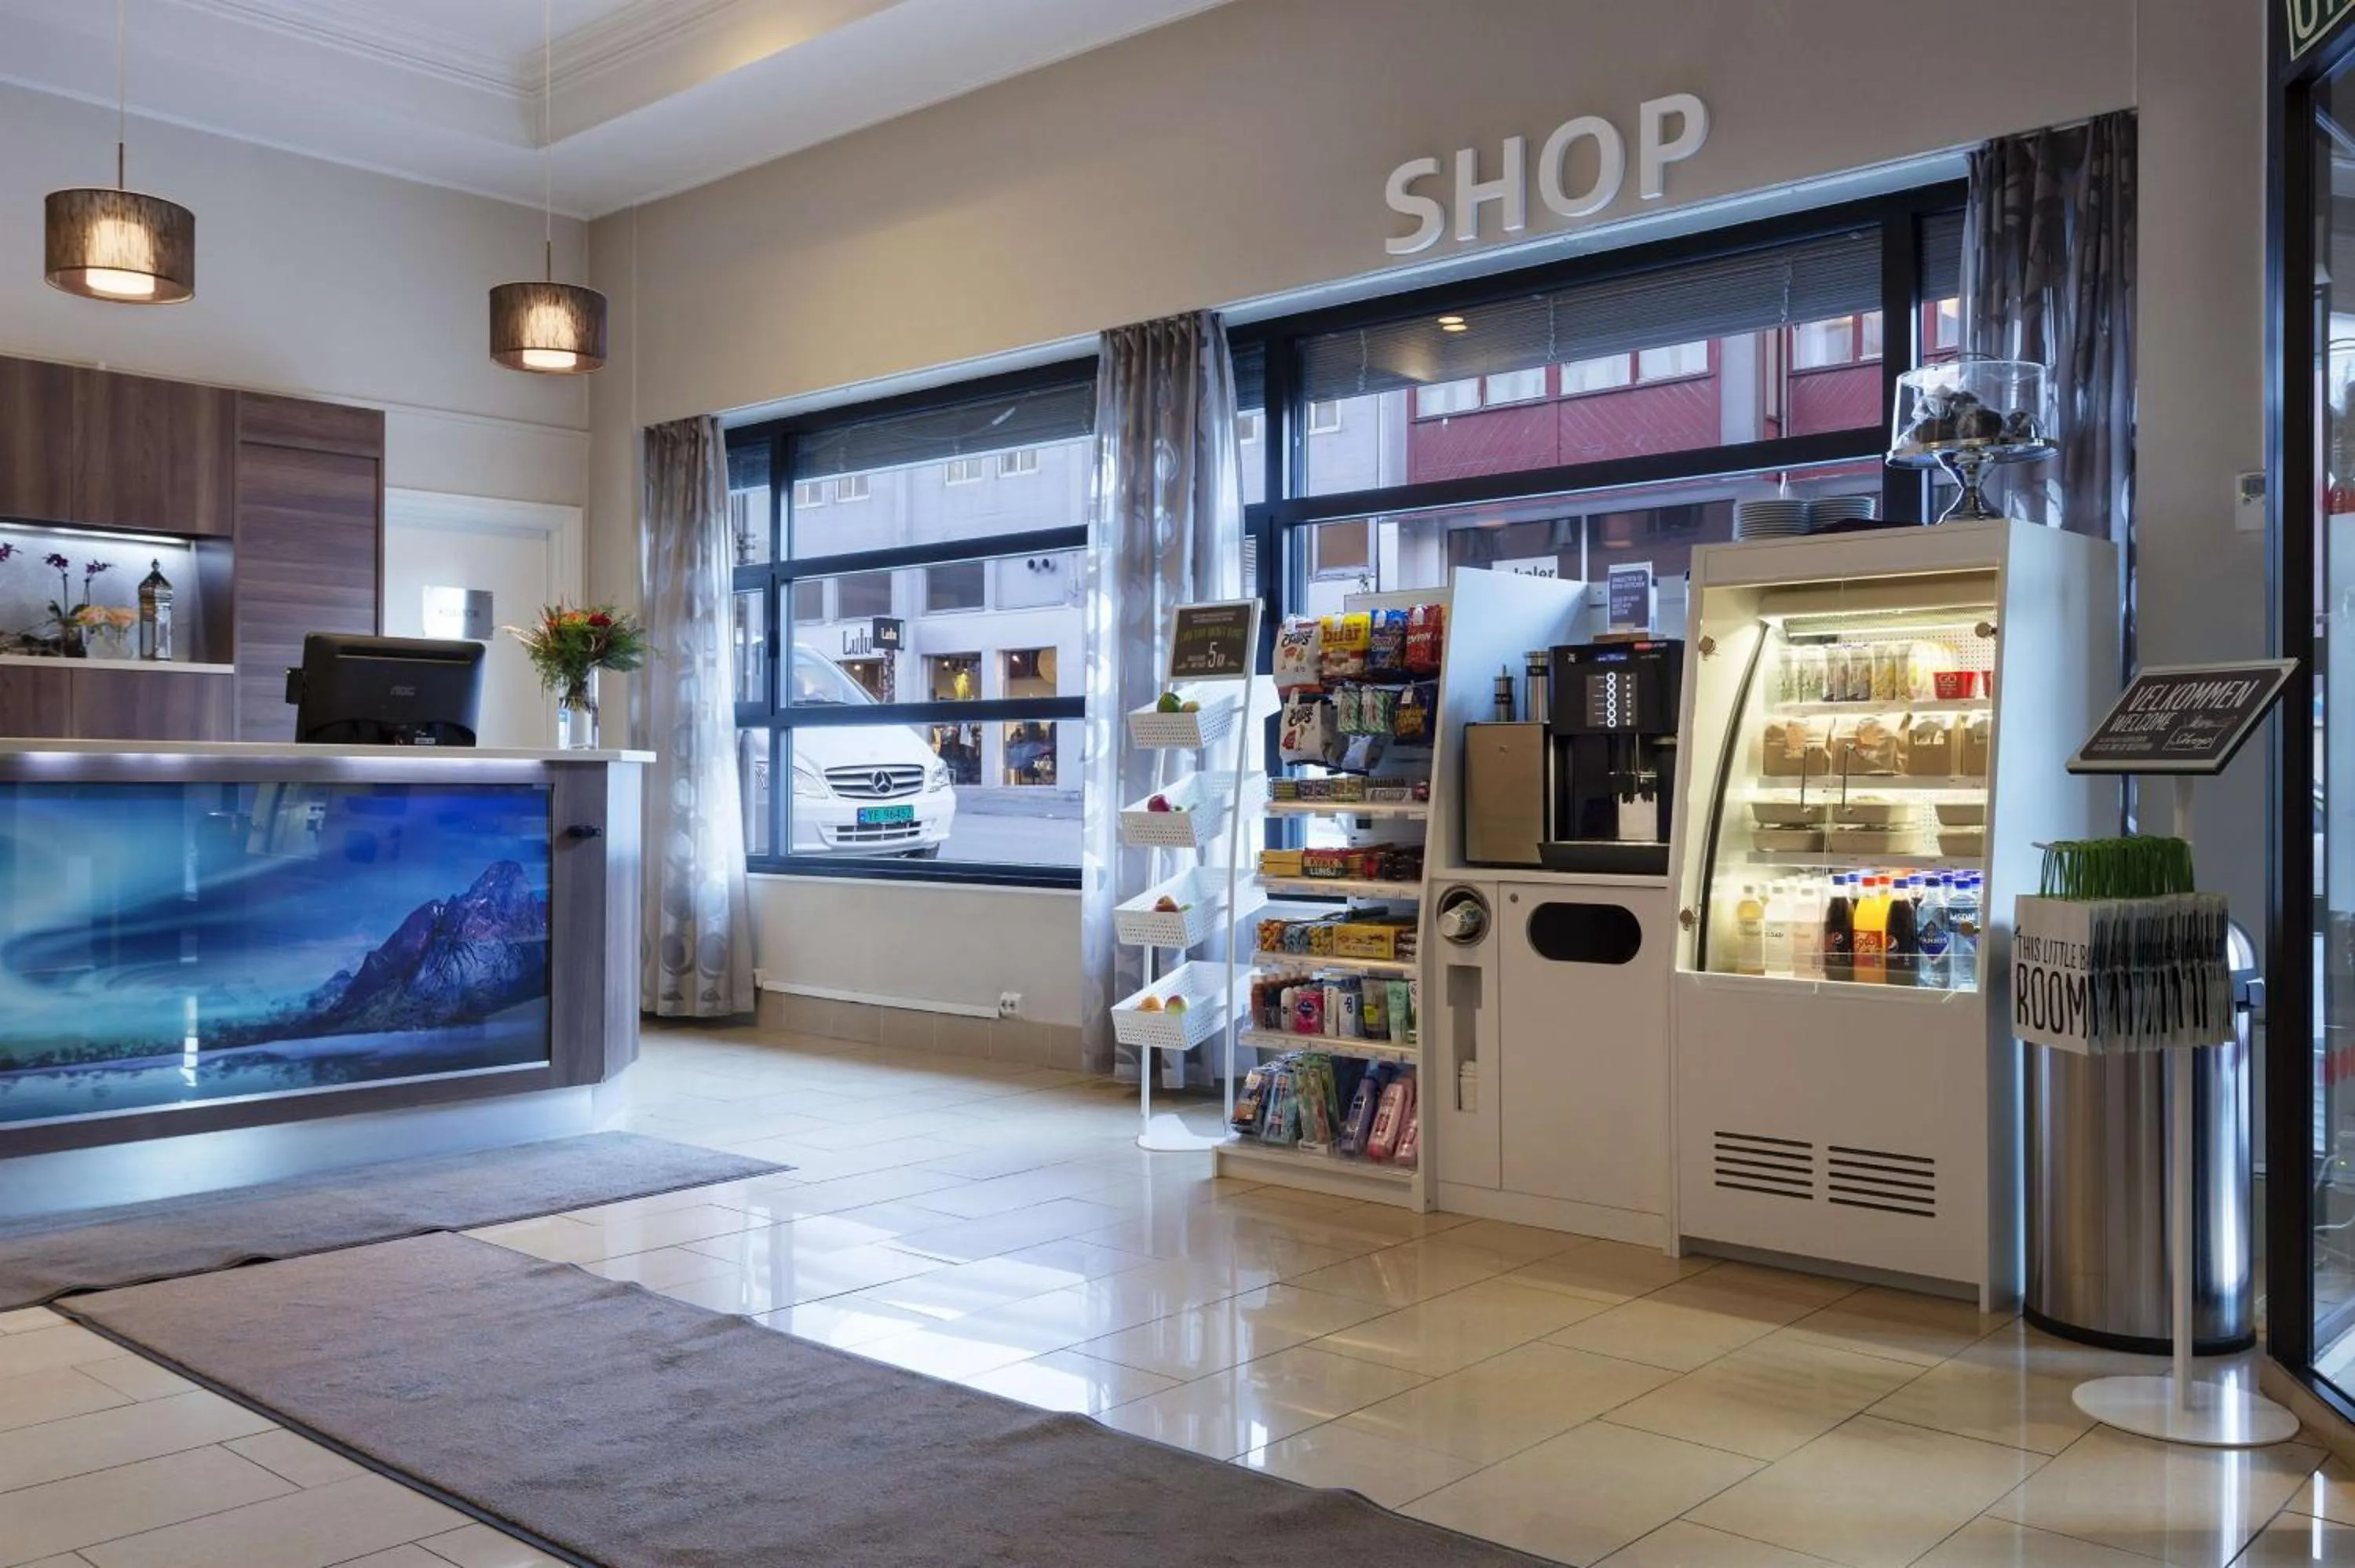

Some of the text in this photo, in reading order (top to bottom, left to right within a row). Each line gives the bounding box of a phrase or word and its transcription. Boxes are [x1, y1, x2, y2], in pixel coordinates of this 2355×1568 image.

[1386, 93, 1709, 255] SHOP
[842, 627, 872, 655] Lulu
[2128, 679, 2260, 711] VELKOMMEN
[2109, 712, 2178, 732] WELCOME
[2017, 935, 2040, 961] THIS
[2043, 939, 2076, 968] LITTLE
